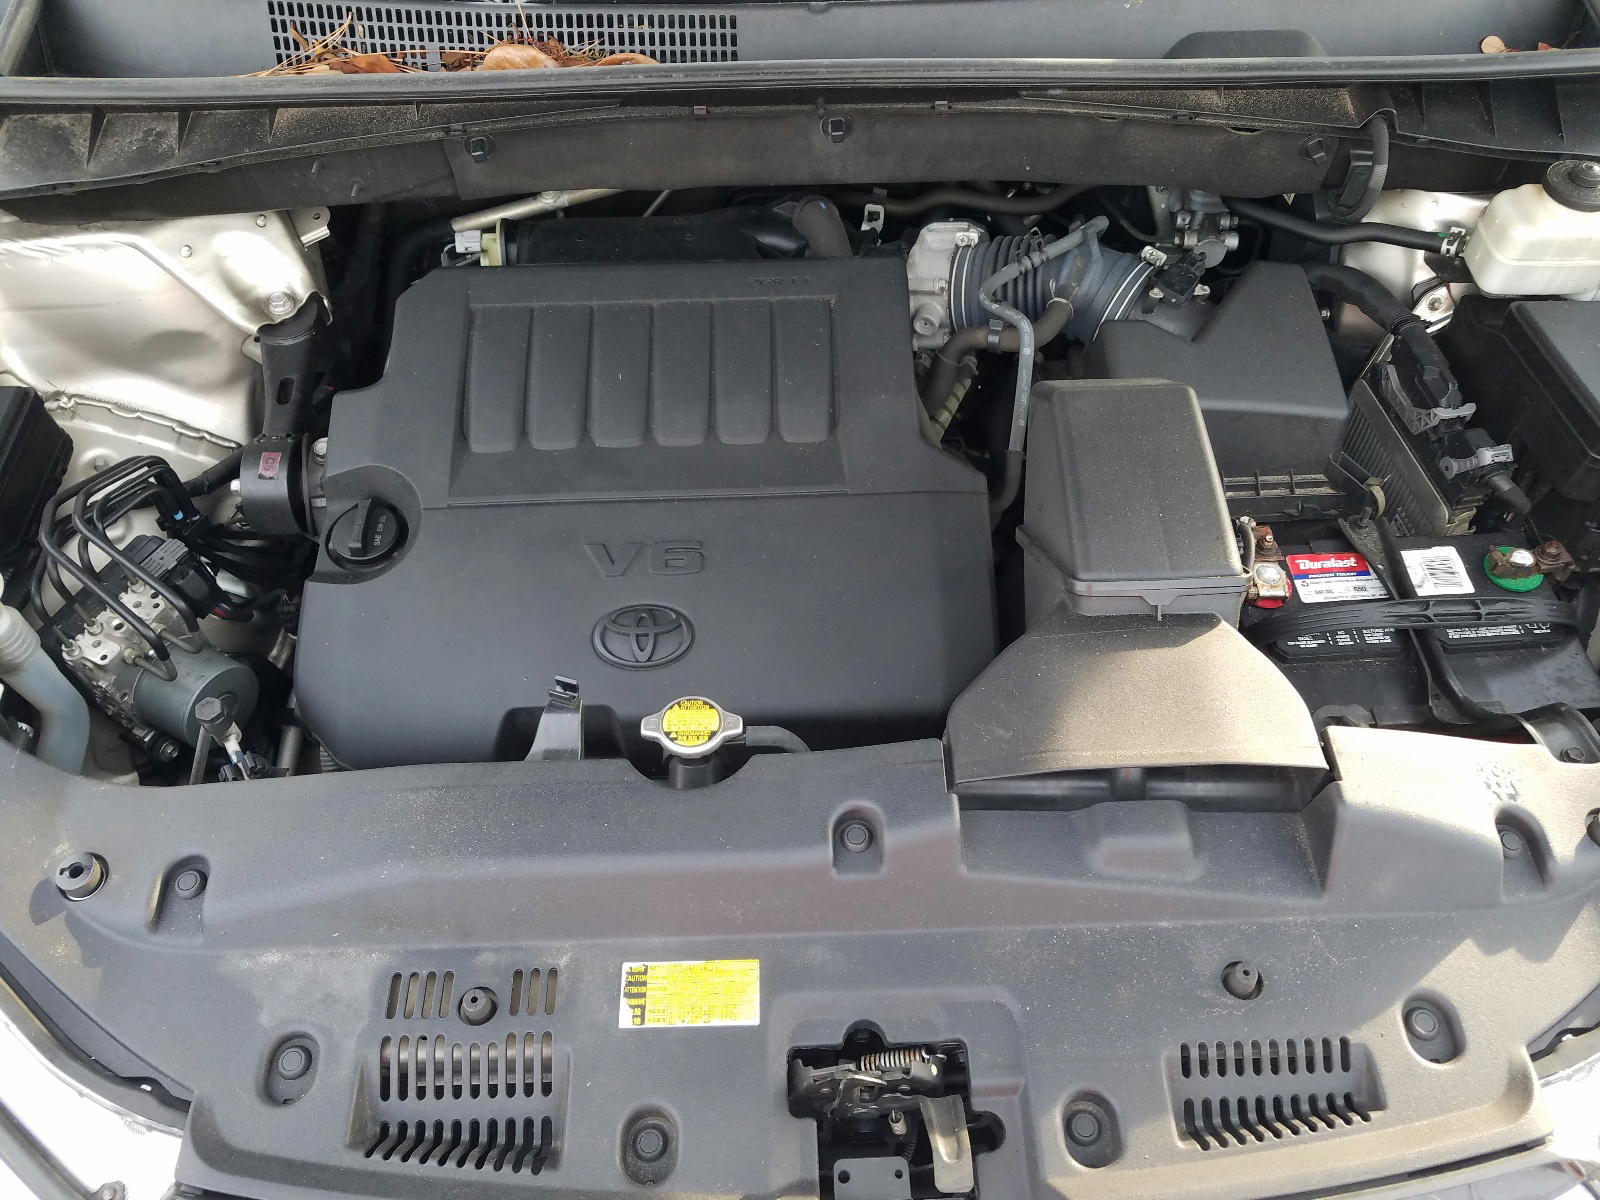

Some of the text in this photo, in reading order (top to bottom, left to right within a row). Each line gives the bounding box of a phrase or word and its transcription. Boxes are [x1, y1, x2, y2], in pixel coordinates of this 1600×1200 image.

[373, 534, 382, 546] SAE
[584, 540, 704, 577] V6
[1295, 557, 1357, 570] Duralast
